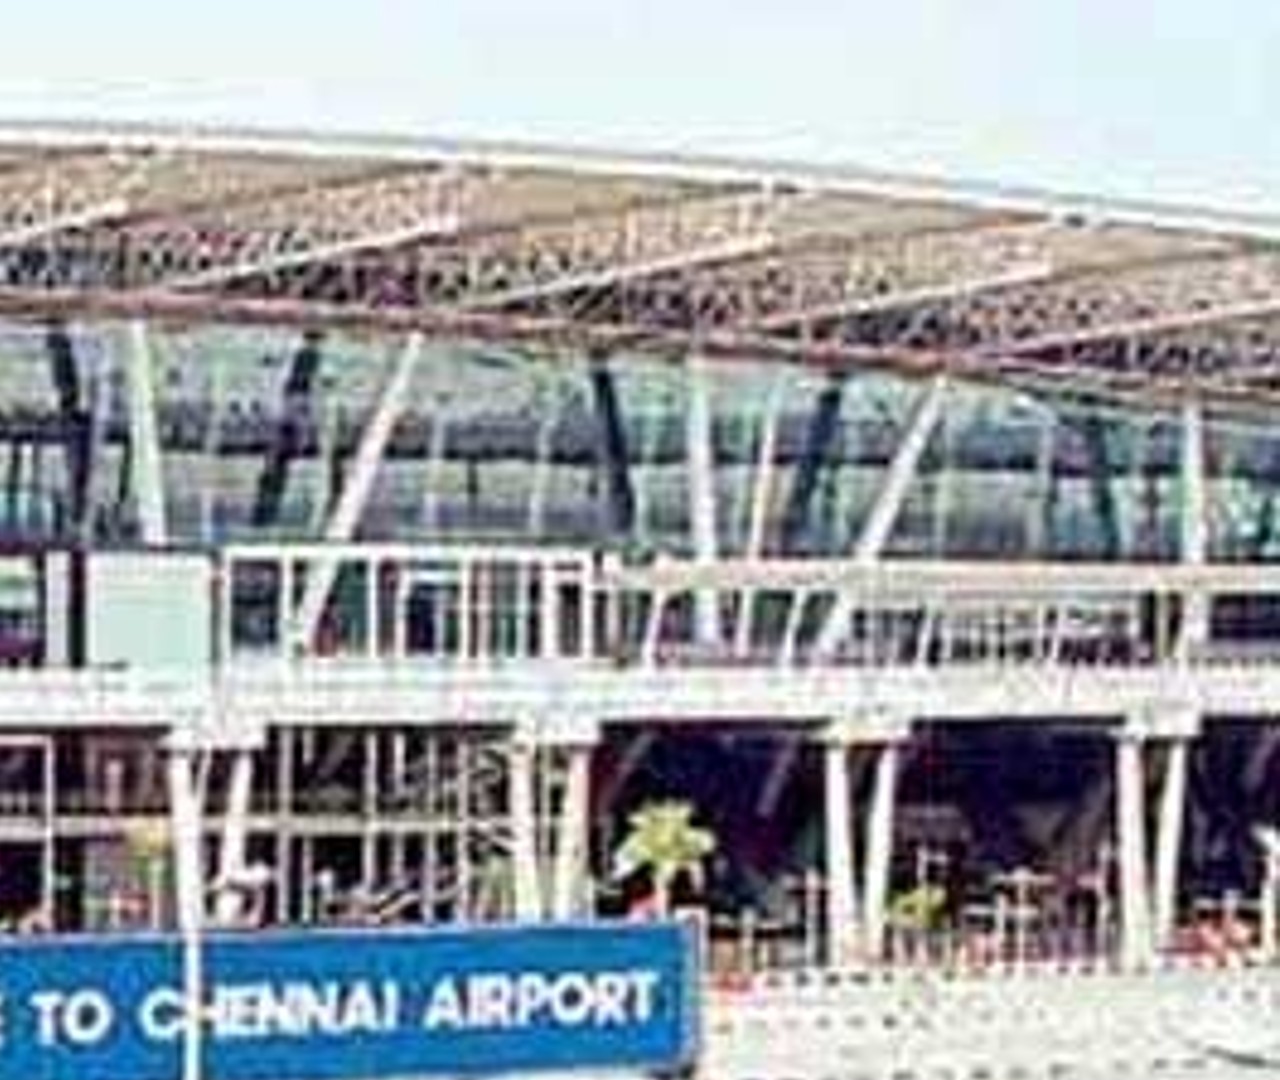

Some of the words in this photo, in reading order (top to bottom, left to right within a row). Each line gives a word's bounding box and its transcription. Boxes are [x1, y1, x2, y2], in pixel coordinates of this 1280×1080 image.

[31, 990, 112, 1045] TO
[139, 981, 399, 1038] CHENNAI
[426, 970, 658, 1029] AIRPORT
